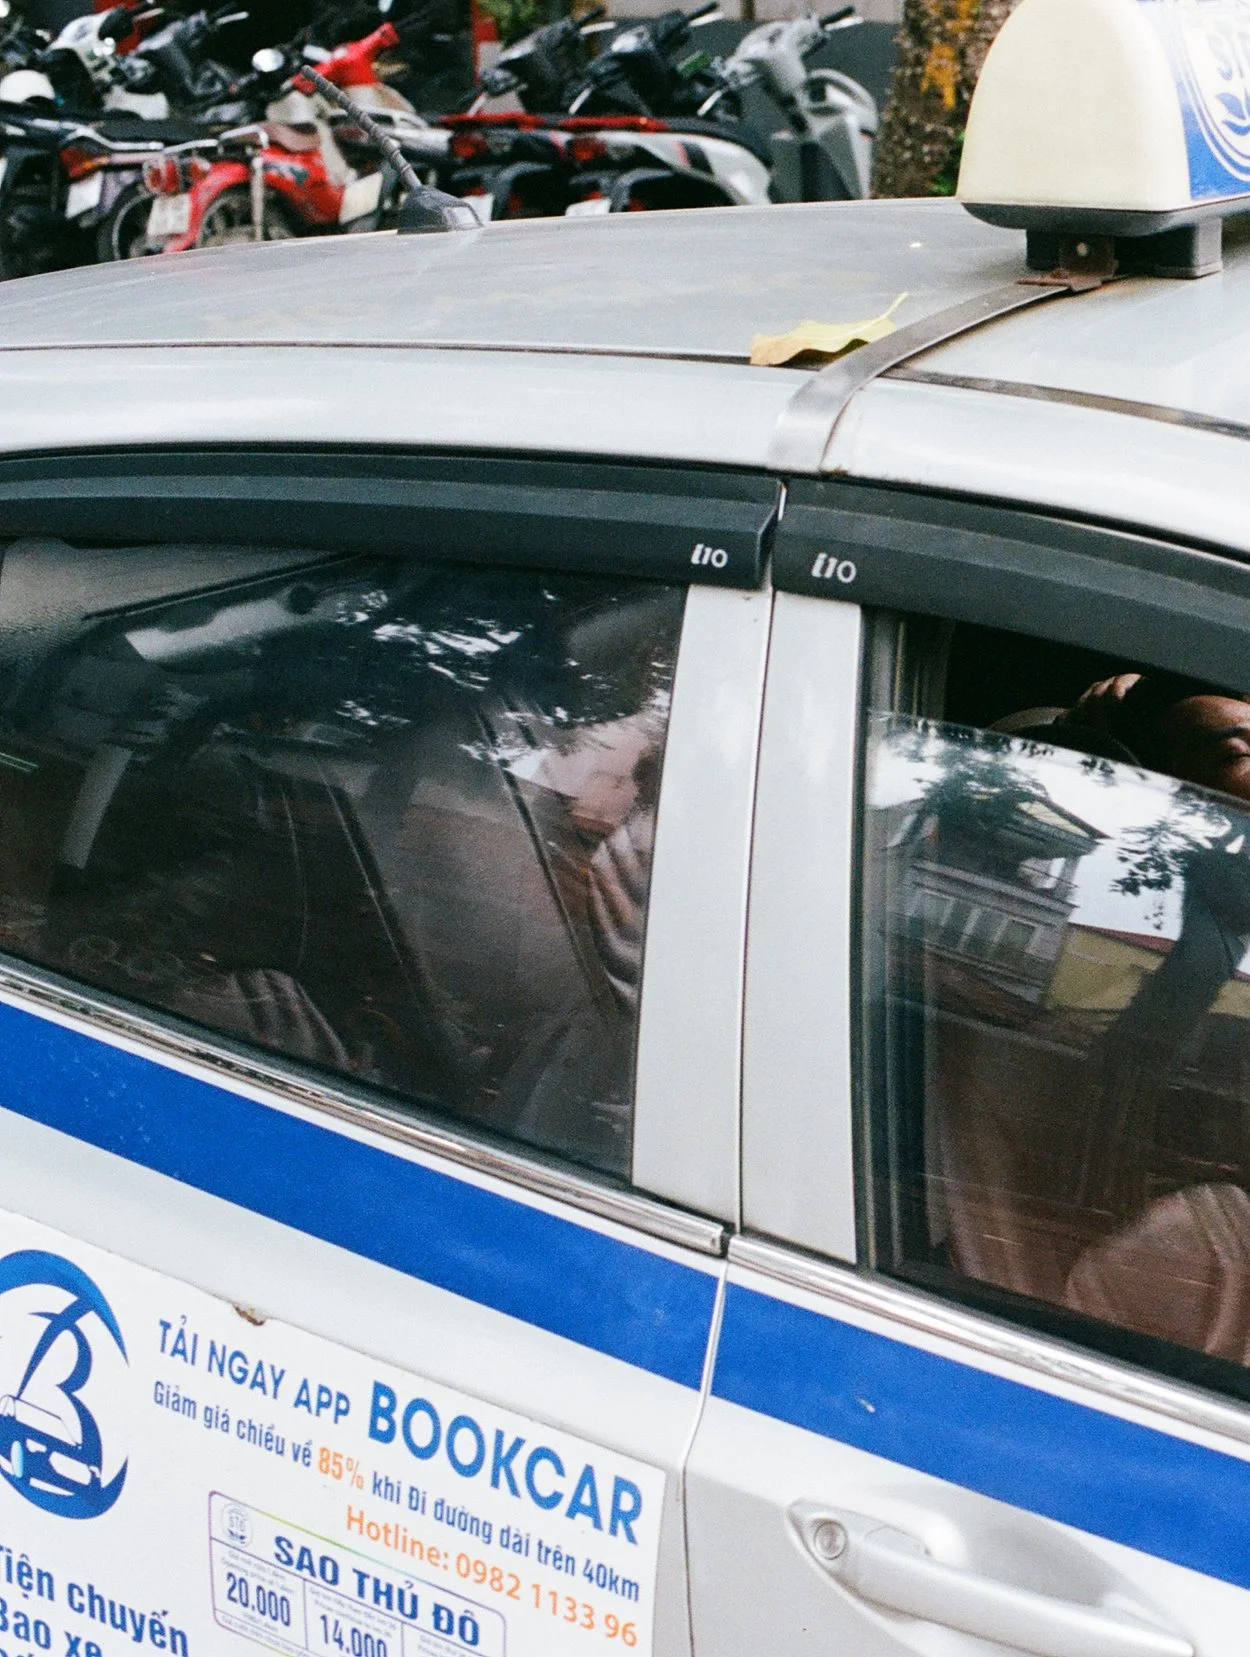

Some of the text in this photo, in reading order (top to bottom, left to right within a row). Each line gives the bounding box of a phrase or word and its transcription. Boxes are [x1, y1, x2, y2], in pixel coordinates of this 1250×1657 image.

[153, 1380, 197, 1420] Giảm
[203, 1405, 230, 1434] giá
[318, 1446, 364, 1489] 85%
[372, 1471, 401, 1505] khi
[408, 1485, 427, 1516] Đi
[433, 1498, 493, 1546] đường
[499, 1524, 531, 1557] dài
[537, 1539, 576, 1577] trên
[582, 1557, 640, 1603] 40km
[159, 1315, 643, 1546] TẢI NGAY APP BOOKCAR
[0, 1544, 54, 1601] iện
[67, 1582, 189, 1657] chuyến
[226, 1572, 291, 1627] 20.000
[274, 1535, 339, 1586] SAO
[352, 1568, 418, 1620] THỦ
[432, 1602, 480, 1646] ĐÔ
[346, 1504, 449, 1571] Hotline:
[456, 1552, 521, 1601] 0982
[532, 1583, 595, 1631] 1133
[605, 1613, 638, 1648] 96
